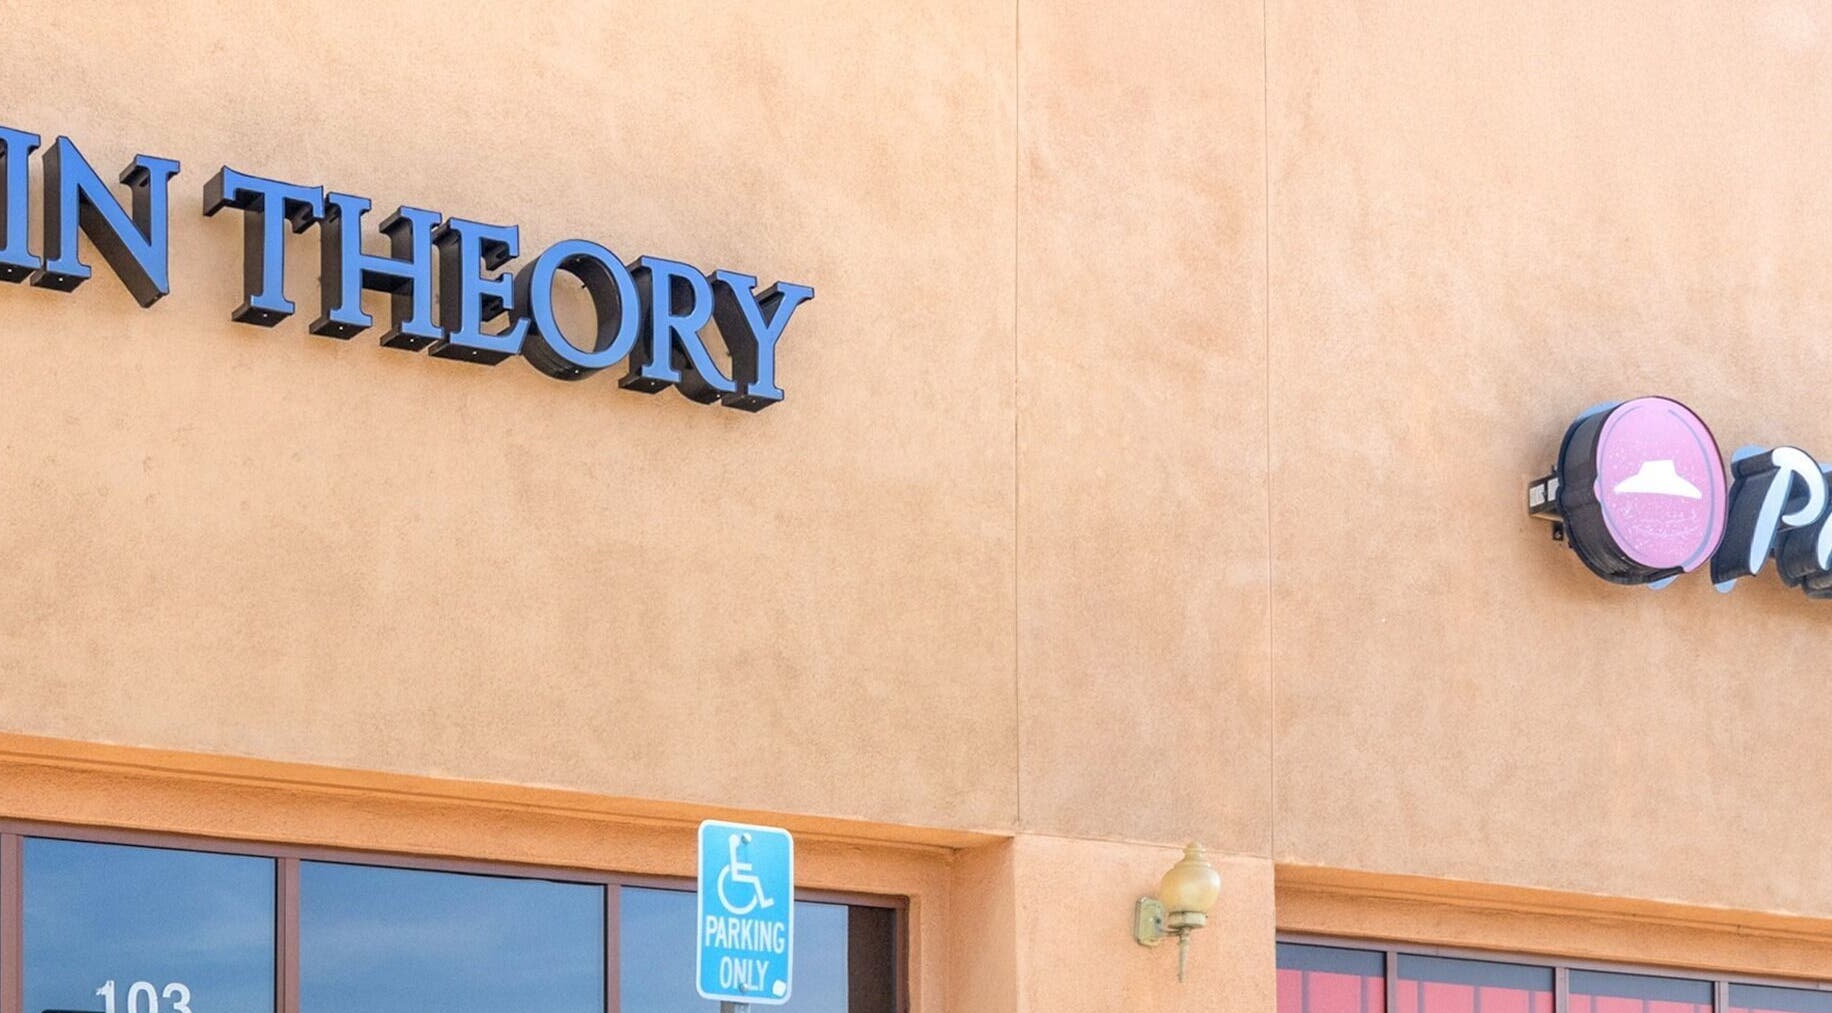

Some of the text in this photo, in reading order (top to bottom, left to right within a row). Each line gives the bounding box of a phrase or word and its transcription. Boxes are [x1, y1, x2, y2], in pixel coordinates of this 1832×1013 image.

[213, 165, 814, 406] THEORY
[705, 915, 785, 954] PARKING
[720, 956, 769, 991] ONLY
